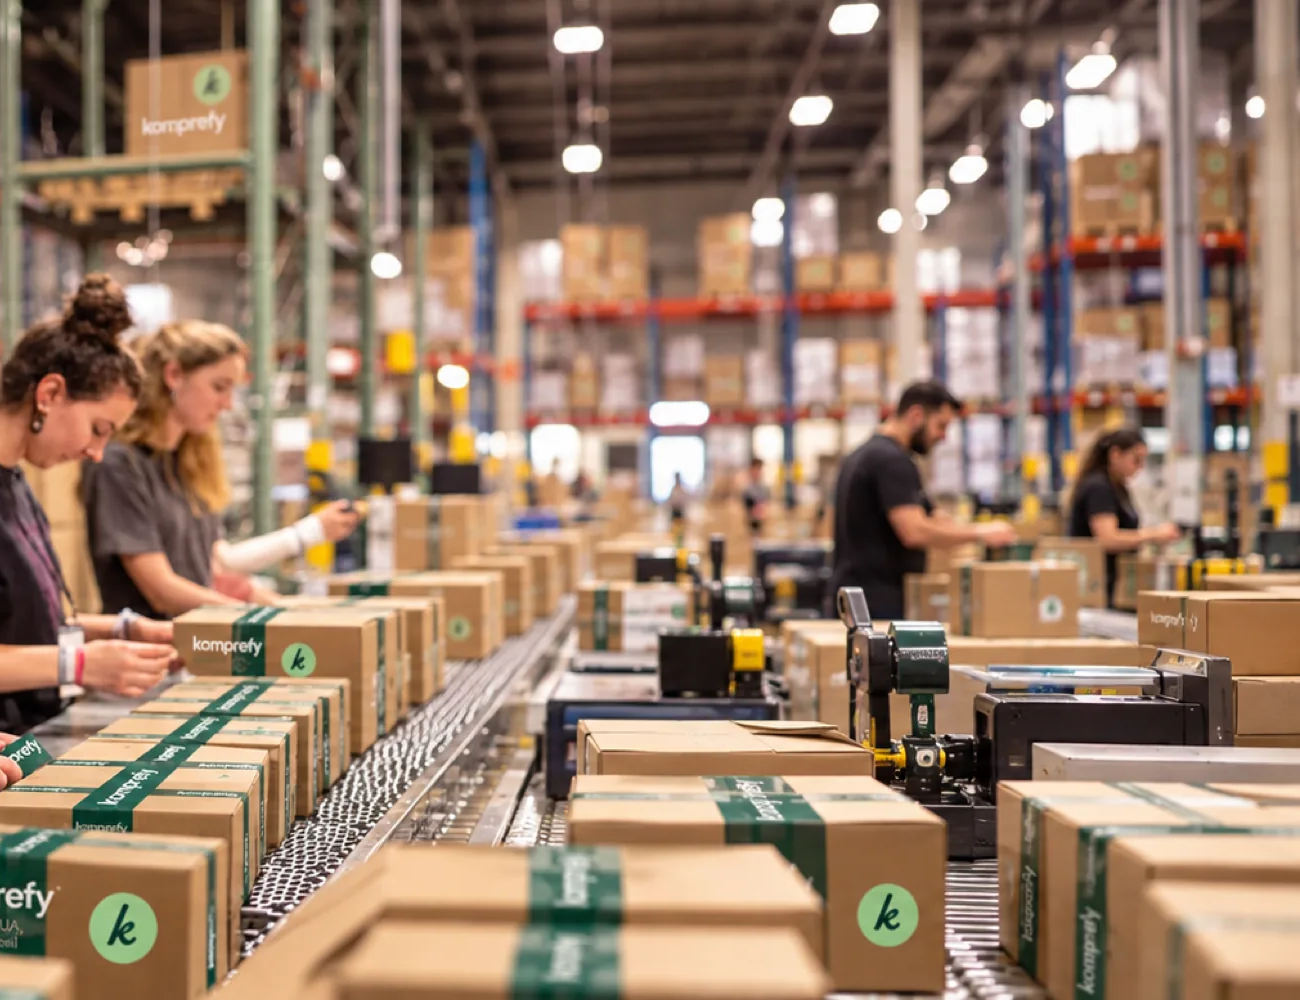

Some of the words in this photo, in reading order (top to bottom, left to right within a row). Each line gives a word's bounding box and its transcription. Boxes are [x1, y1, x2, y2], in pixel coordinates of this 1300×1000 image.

[192, 636, 263, 657] komprefy
[290, 648, 306, 671] k
[107, 903, 137, 946] k
[873, 892, 901, 931] k
